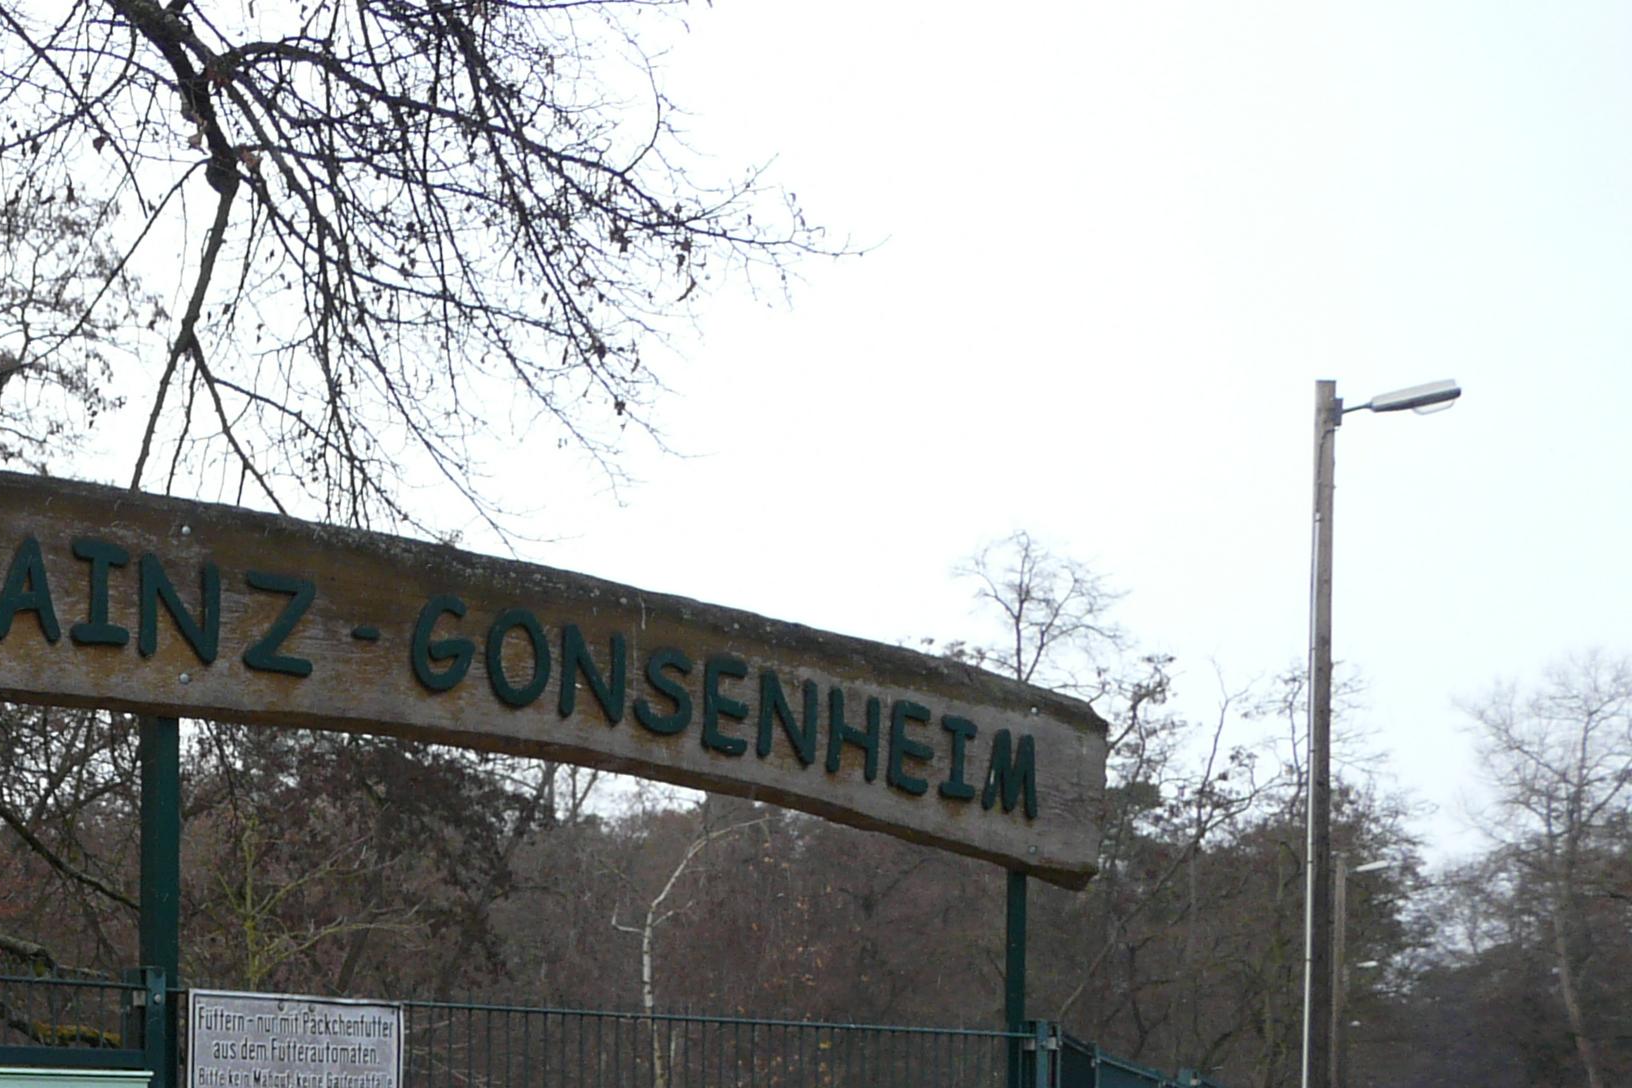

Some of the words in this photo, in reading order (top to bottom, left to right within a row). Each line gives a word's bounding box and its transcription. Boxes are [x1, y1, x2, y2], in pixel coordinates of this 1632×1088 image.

[198, 1006, 244, 1032] Füttern
[257, 1014, 277, 1033] nur
[280, 1013, 298, 1034] mit
[302, 1012, 393, 1038] Päckchenfutter
[213, 1041, 236, 1060] aus
[241, 1037, 266, 1061] dem
[271, 1038, 380, 1065] Futterautomaten.
[199, 1067, 225, 1086] Bitte
[228, 1069, 250, 1087] kein
[297, 1071, 323, 1088] keine
